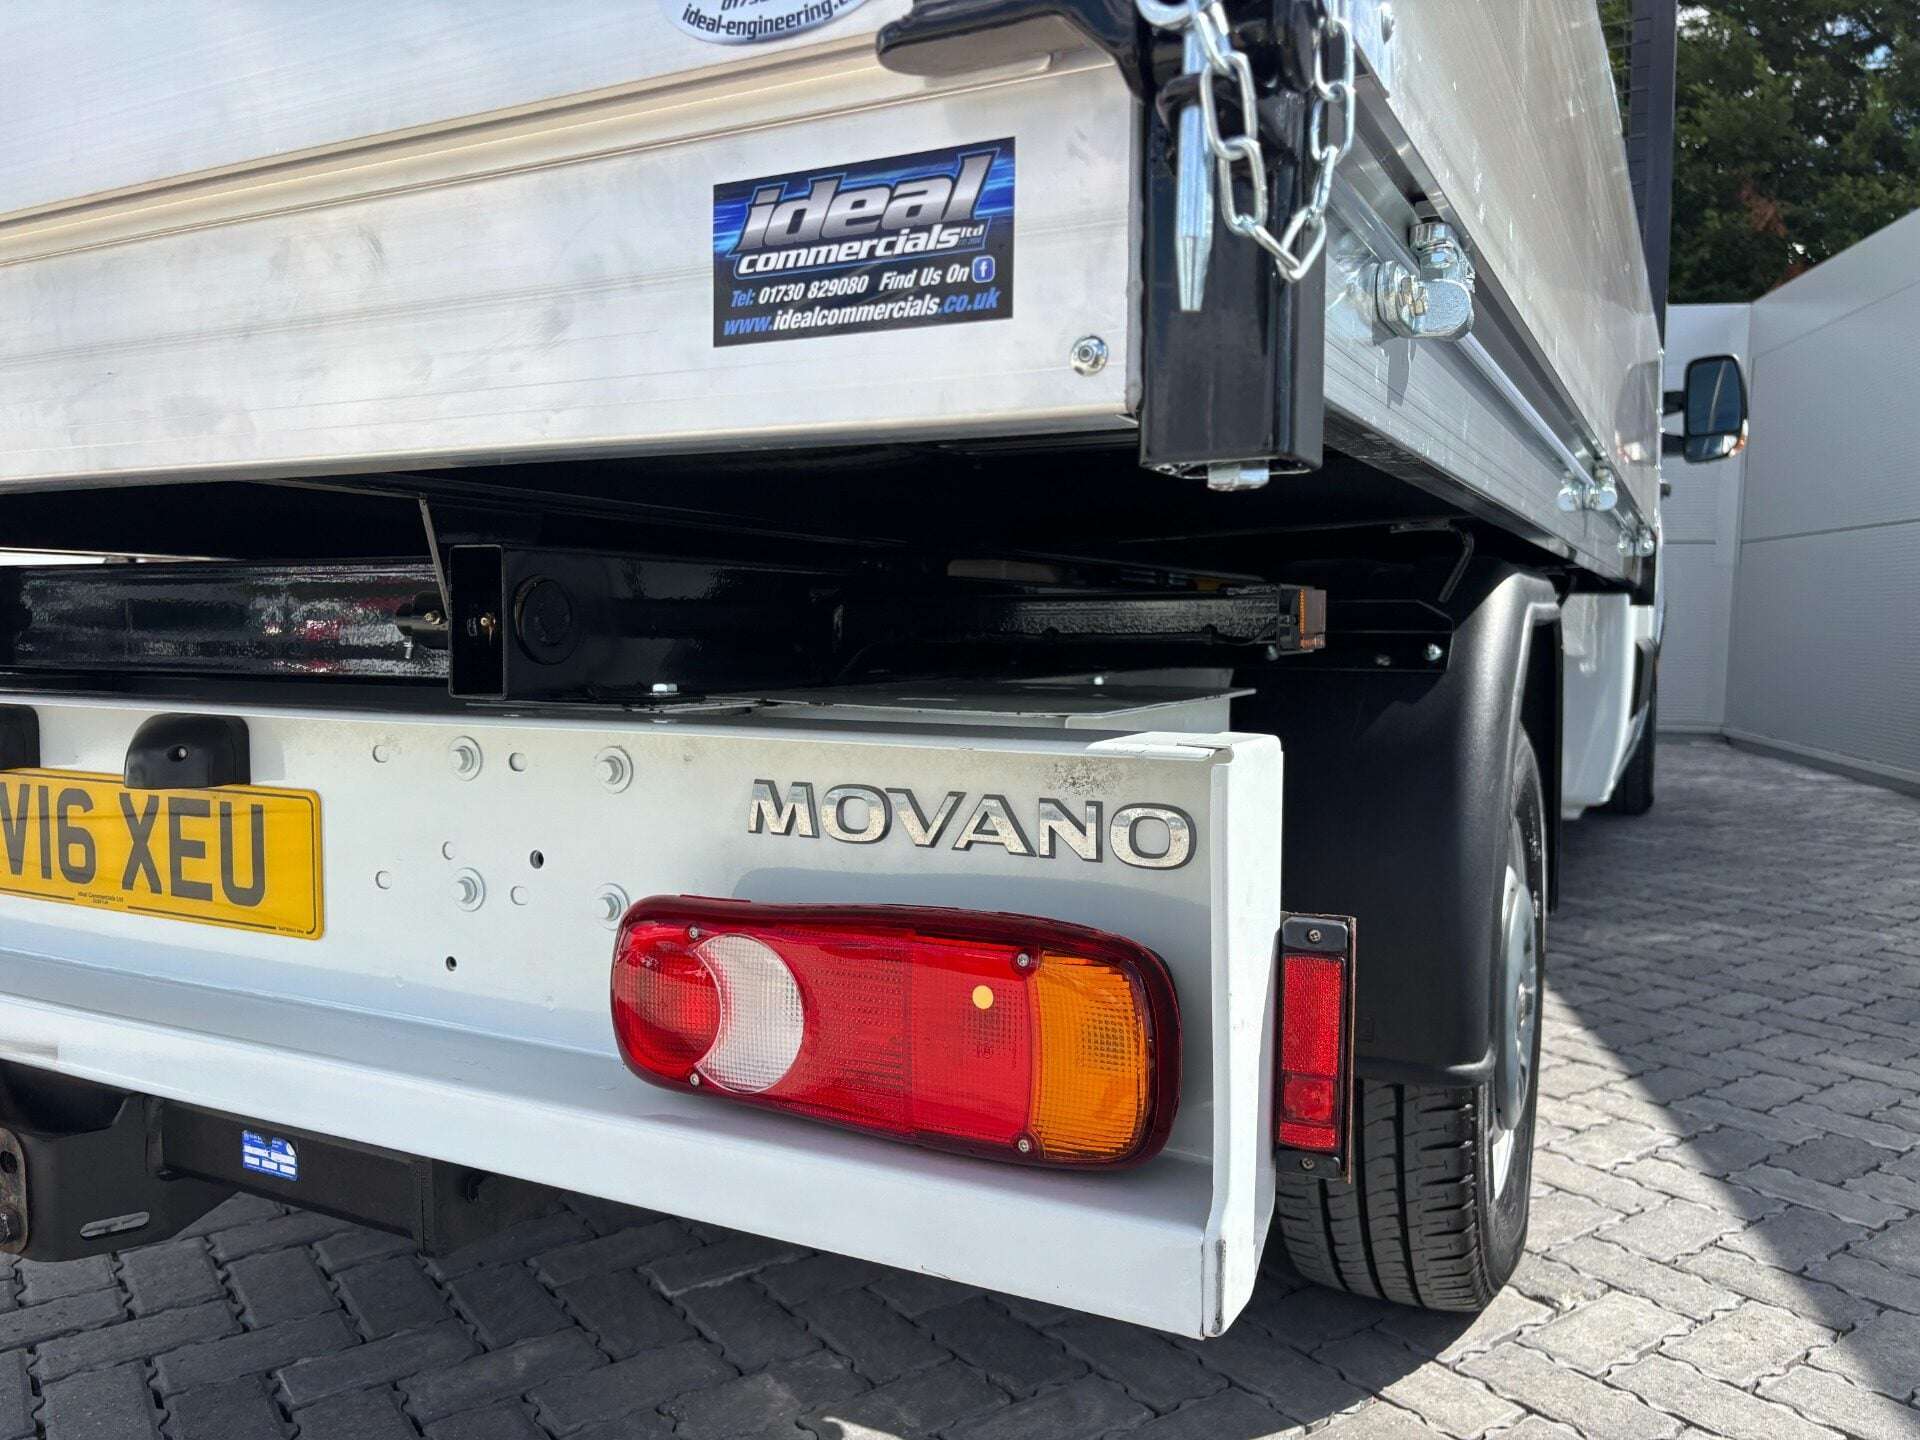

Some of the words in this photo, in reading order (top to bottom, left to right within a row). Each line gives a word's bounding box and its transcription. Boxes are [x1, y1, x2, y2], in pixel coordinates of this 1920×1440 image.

[736, 149, 1000, 250] ideal
[738, 224, 961, 275] commercials
[723, 288, 1001, 336] www.idealcommercials.co.uk
[731, 290, 755, 308] Tel:
[759, 283, 801, 304] 01730
[807, 276, 869, 299] 829080
[879, 270, 918, 291] Find
[920, 267, 943, 286] Us
[945, 263, 969, 284] On
[118, 792, 266, 907] XEU
[748, 779, 1196, 870] MOVANO
